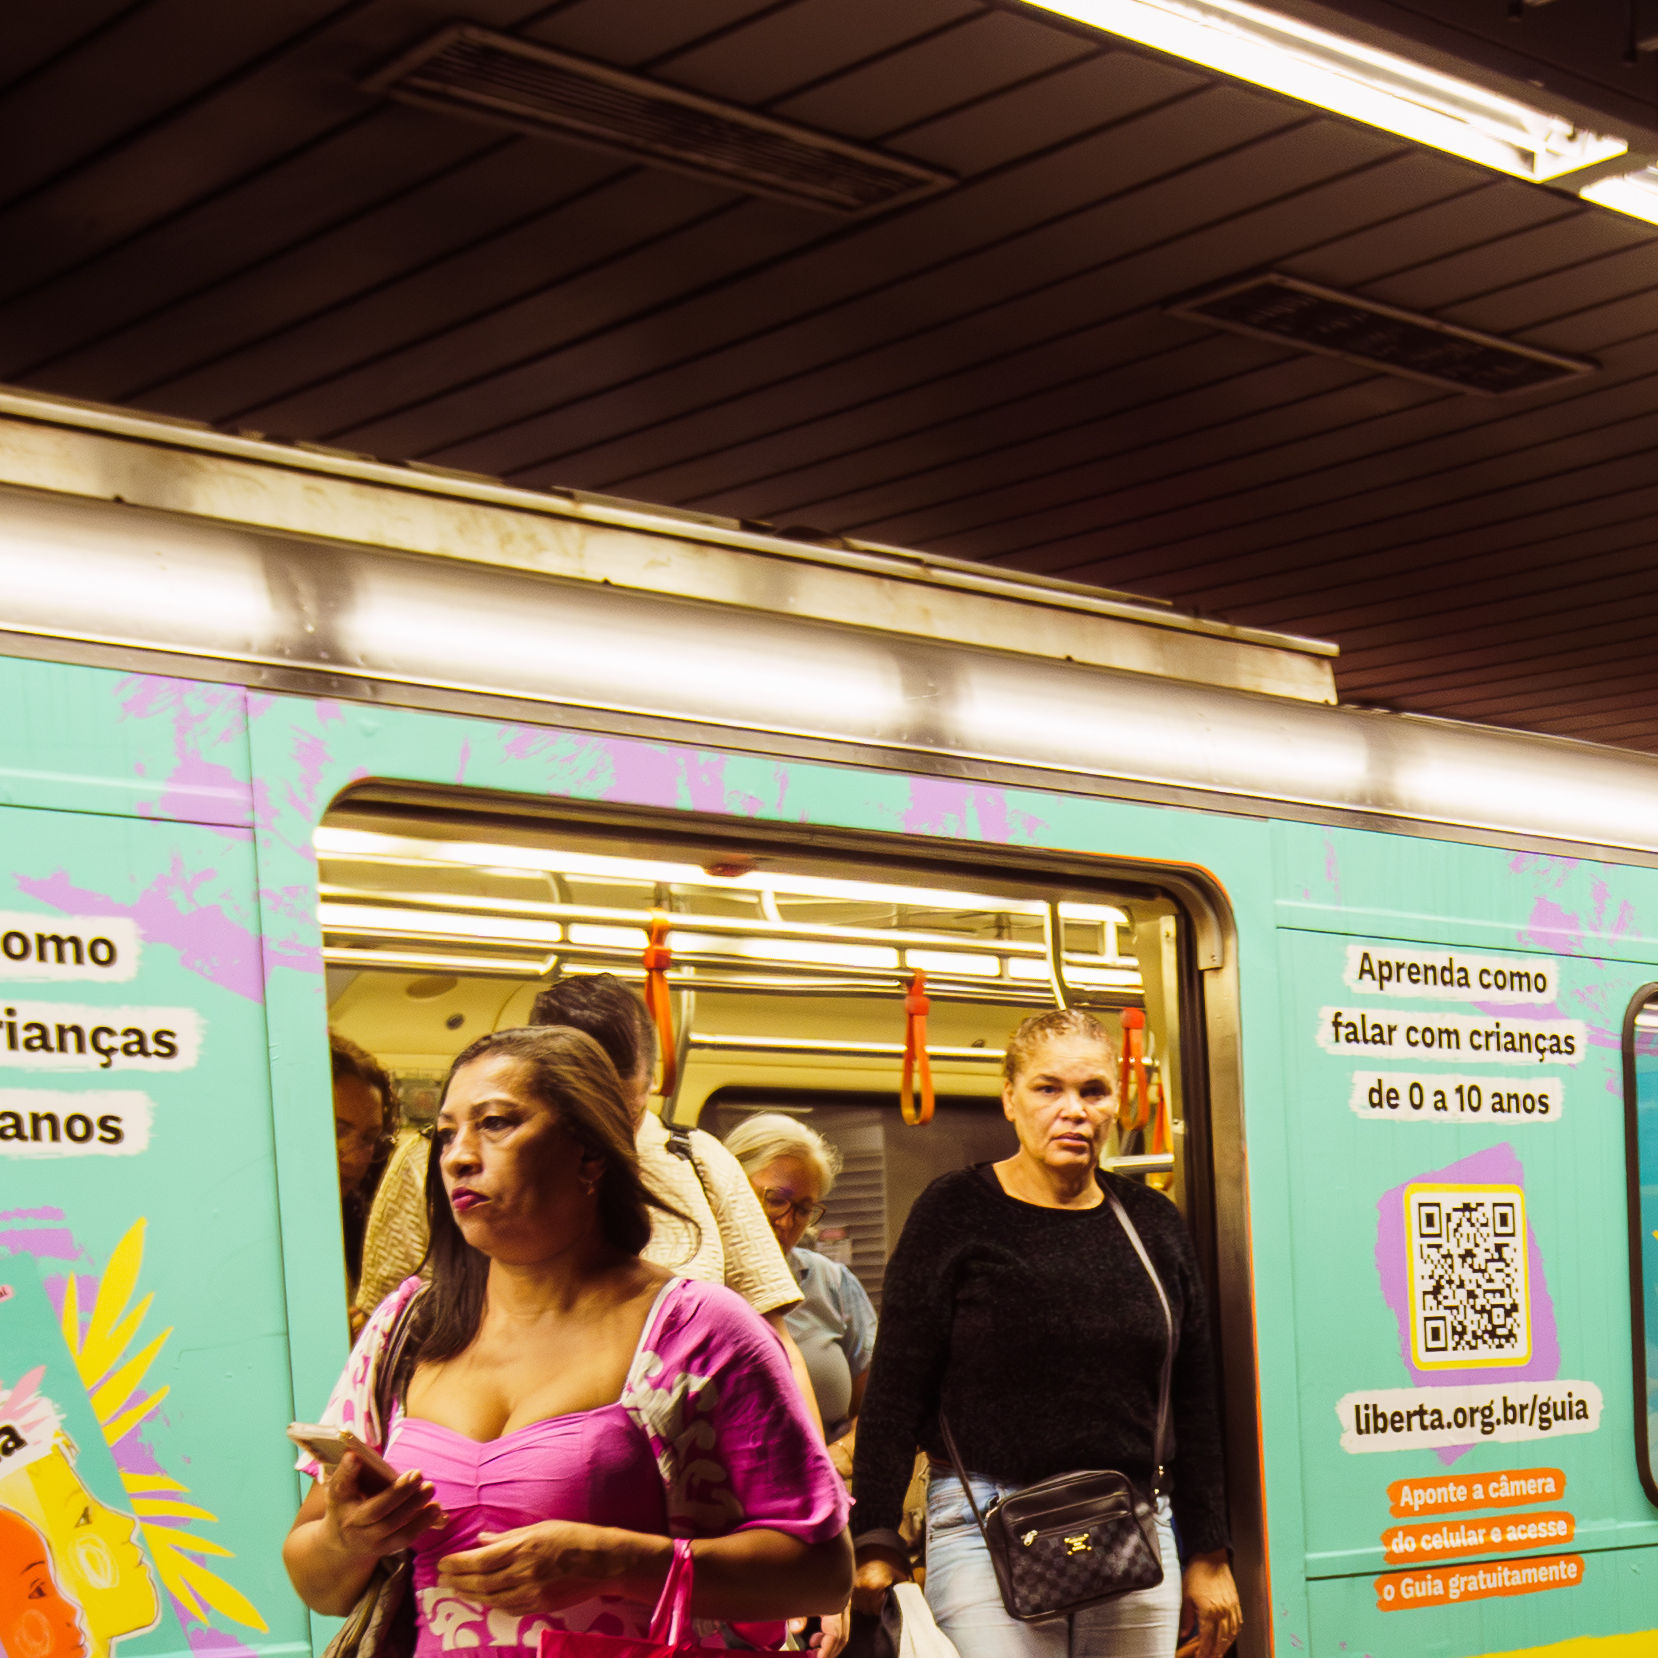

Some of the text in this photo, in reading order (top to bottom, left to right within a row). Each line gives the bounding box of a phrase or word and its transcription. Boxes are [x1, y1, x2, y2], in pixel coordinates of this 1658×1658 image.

[1359, 952, 1547, 993] Aprenda como
[1332, 1012, 1575, 1062] falar com crianças
[1368, 1079, 1549, 1114] de 0 a 10 anos
[1354, 1391, 1588, 1435] liberta.org.br/guia
[1400, 1475, 1555, 1510] Aponte a câmera
[1391, 1518, 1568, 1554] do celular e acesse
[1383, 1559, 1577, 1601] o Guia gratuitamente
